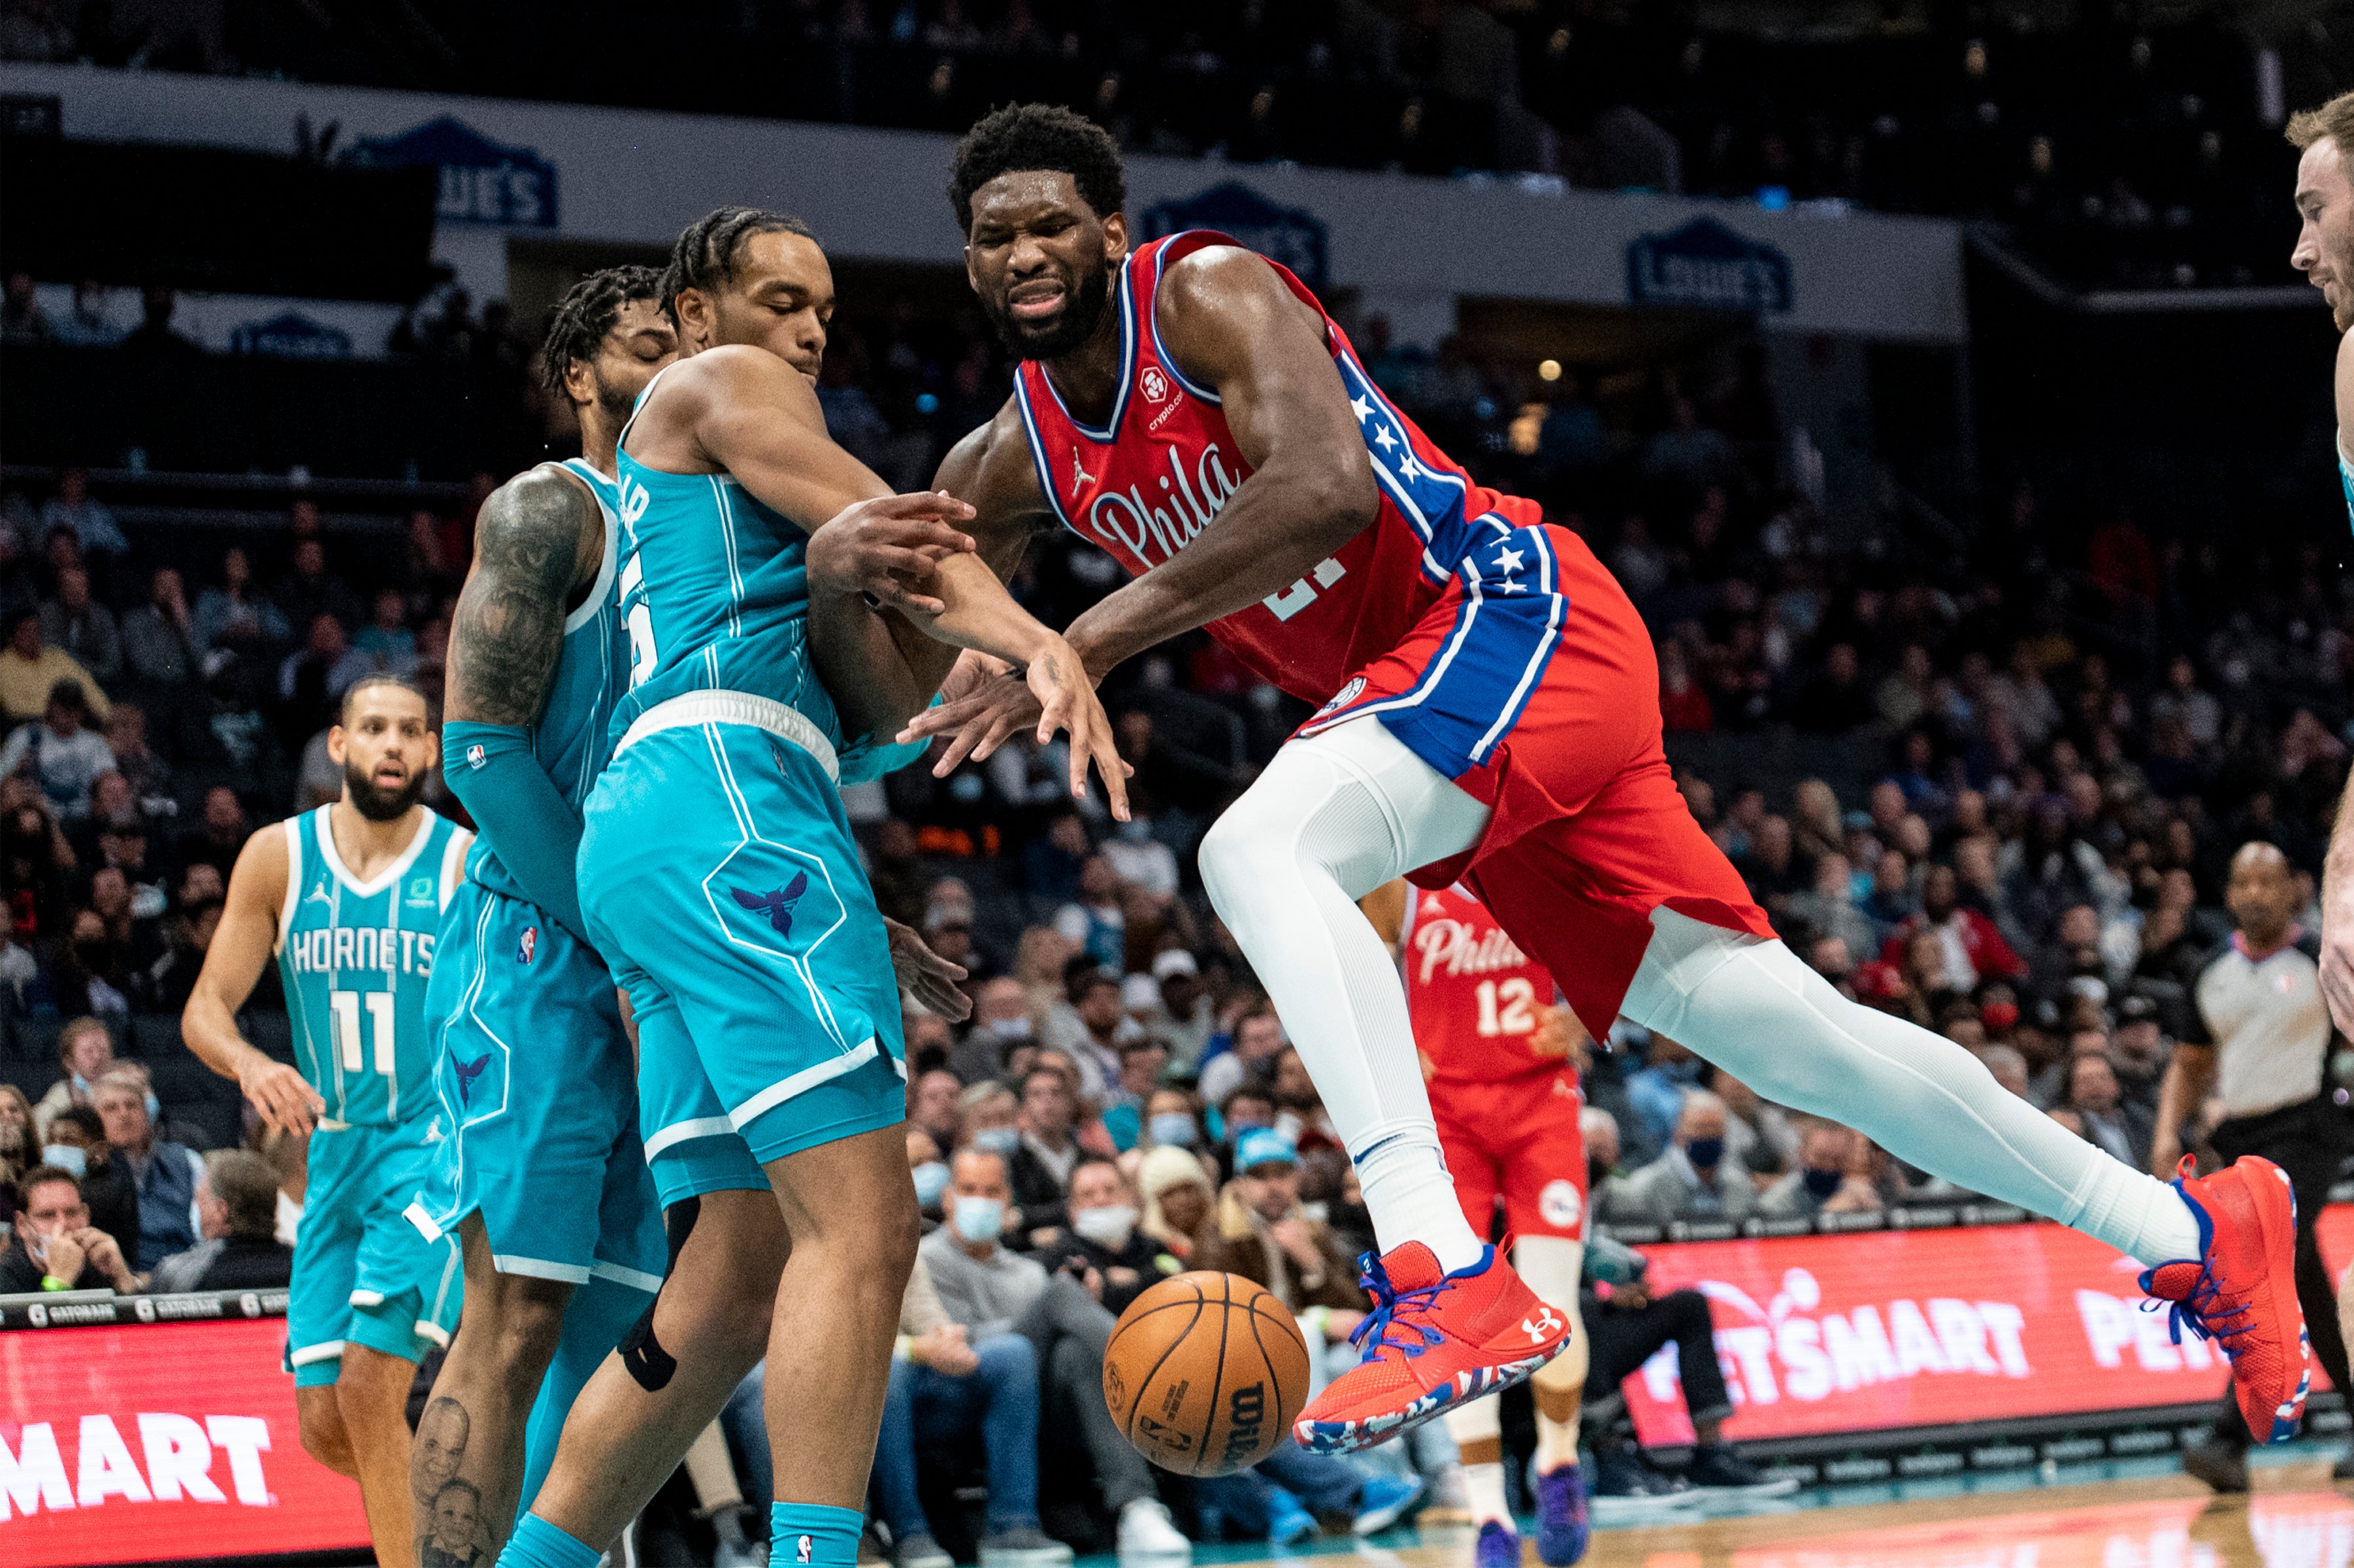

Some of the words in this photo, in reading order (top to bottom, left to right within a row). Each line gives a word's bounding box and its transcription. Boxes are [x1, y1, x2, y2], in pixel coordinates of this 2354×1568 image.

[1090, 442, 1241, 570] Phila
[292, 926, 436, 978] HORNETS
[330, 990, 395, 1075] 11
[1475, 977, 1535, 1037] 12
